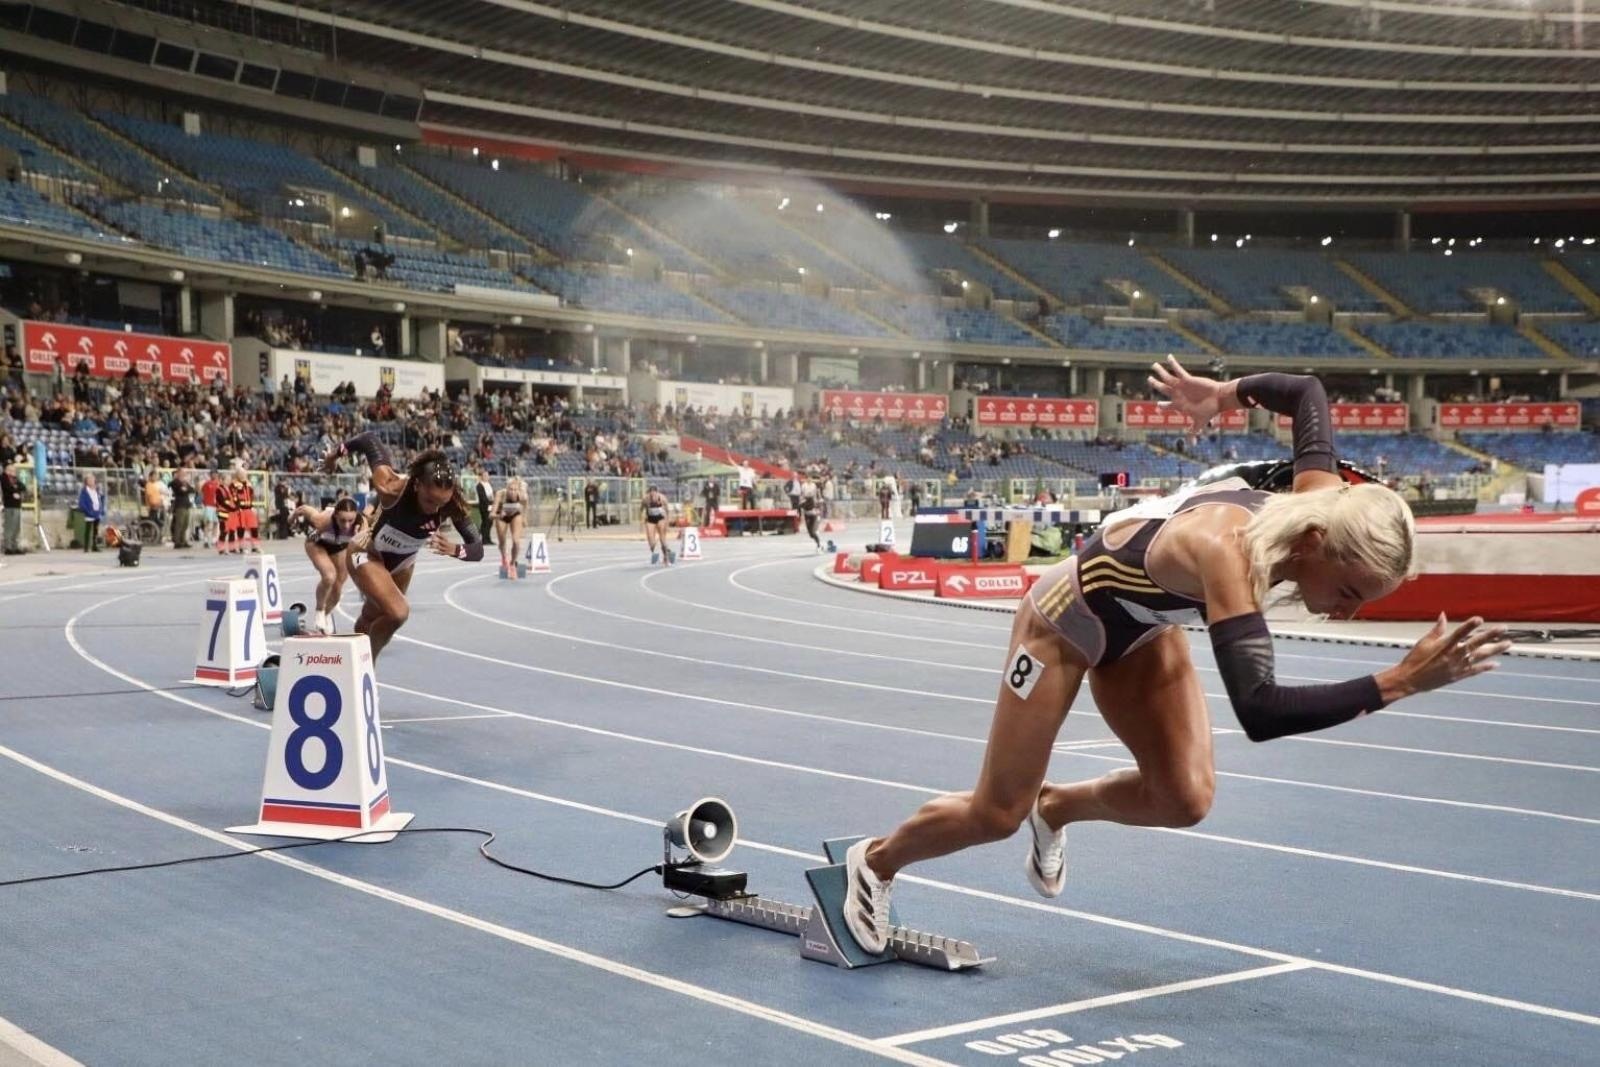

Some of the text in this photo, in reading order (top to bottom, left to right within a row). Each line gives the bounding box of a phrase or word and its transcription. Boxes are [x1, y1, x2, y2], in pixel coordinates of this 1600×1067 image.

[688, 534, 697, 552] 3
[883, 526, 893, 543] 2
[536, 541, 546, 564] 4
[266, 568, 278, 607] 6
[892, 571, 936, 585] PZL
[978, 577, 1019, 588] ORLEN
[206, 599, 227, 661] 7
[235, 599, 256, 661] 7
[306, 654, 343, 666] polanik
[1010, 654, 1033, 689] 8
[284, 674, 343, 790] 8
[362, 672, 380, 785] 8
[964, 1028, 1074, 1056] 400
